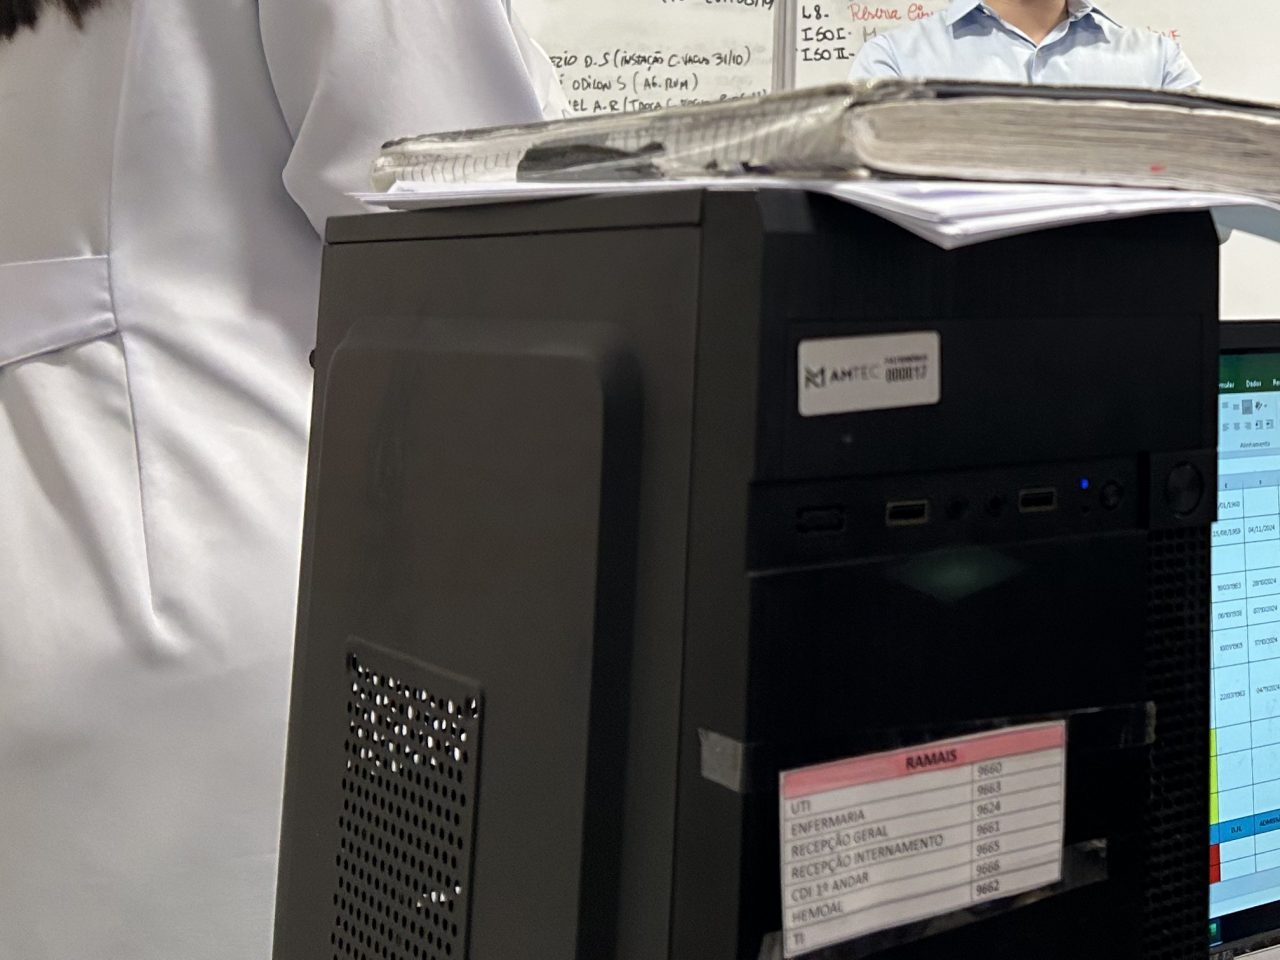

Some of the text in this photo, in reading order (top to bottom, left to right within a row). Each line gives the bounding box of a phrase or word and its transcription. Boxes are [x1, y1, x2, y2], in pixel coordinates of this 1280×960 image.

[904, 749, 959, 771] RAMAIS
[790, 799, 812, 816] UTI
[790, 809, 867, 837] ENFERMARIA
[790, 832, 852, 859] RECEPÇÃO
[853, 824, 889, 845] GERAL
[790, 853, 852, 880] RECEPÇÃO
[853, 833, 945, 864] INTERNAMENTO
[831, 871, 870, 893] ANDAR
